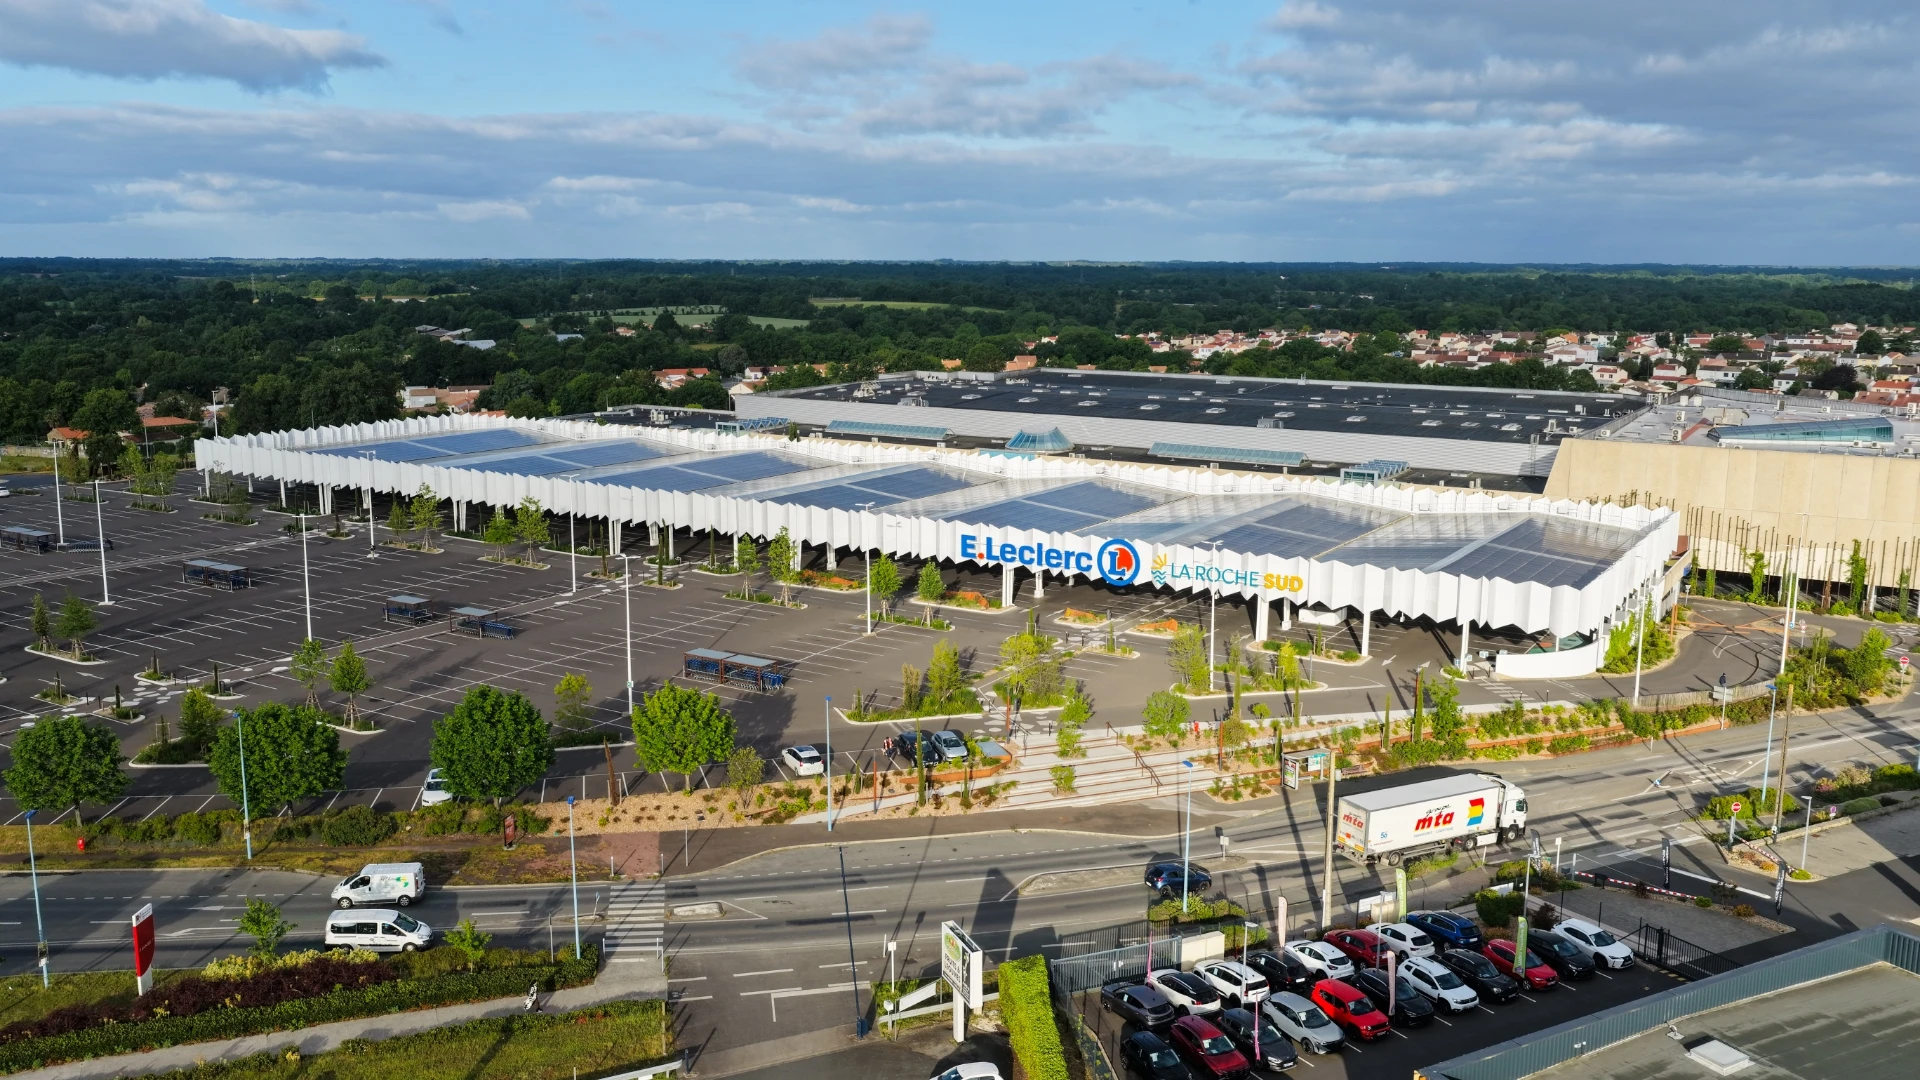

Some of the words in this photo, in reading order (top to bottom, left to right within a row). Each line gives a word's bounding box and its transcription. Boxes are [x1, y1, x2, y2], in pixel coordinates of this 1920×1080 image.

[961, 534, 1093, 572] E.Leclerc
[1171, 562, 1191, 580] LA
[1195, 565, 1260, 587] ROCHE
[1263, 573, 1304, 592] SUD
[1342, 813, 1364, 828] mta
[1415, 811, 1455, 831] mta
